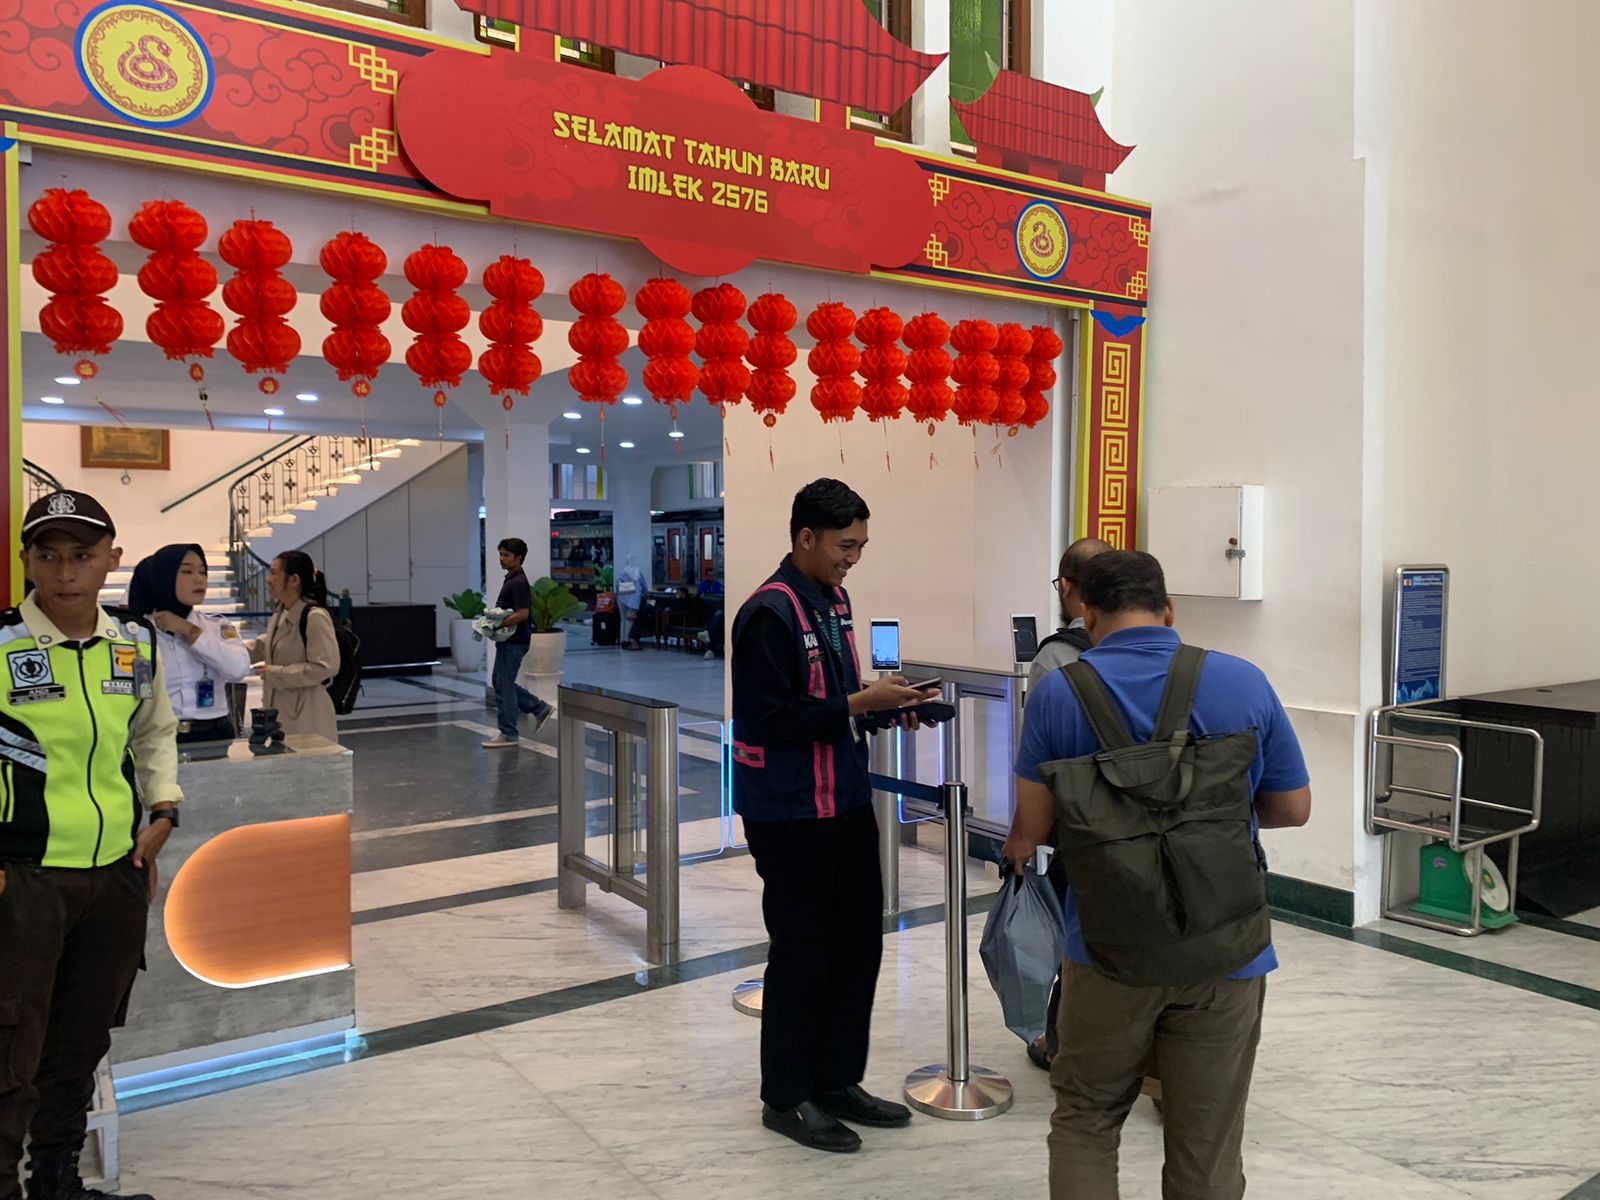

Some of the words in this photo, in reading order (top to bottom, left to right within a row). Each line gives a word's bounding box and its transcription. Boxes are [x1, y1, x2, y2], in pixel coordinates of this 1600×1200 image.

[553, 111, 676, 160] SELAMAT
[683, 138, 763, 177] TAHUN
[770, 156, 830, 190] BARU
[627, 165, 704, 202] IMLEK
[711, 181, 768, 214] 2576
